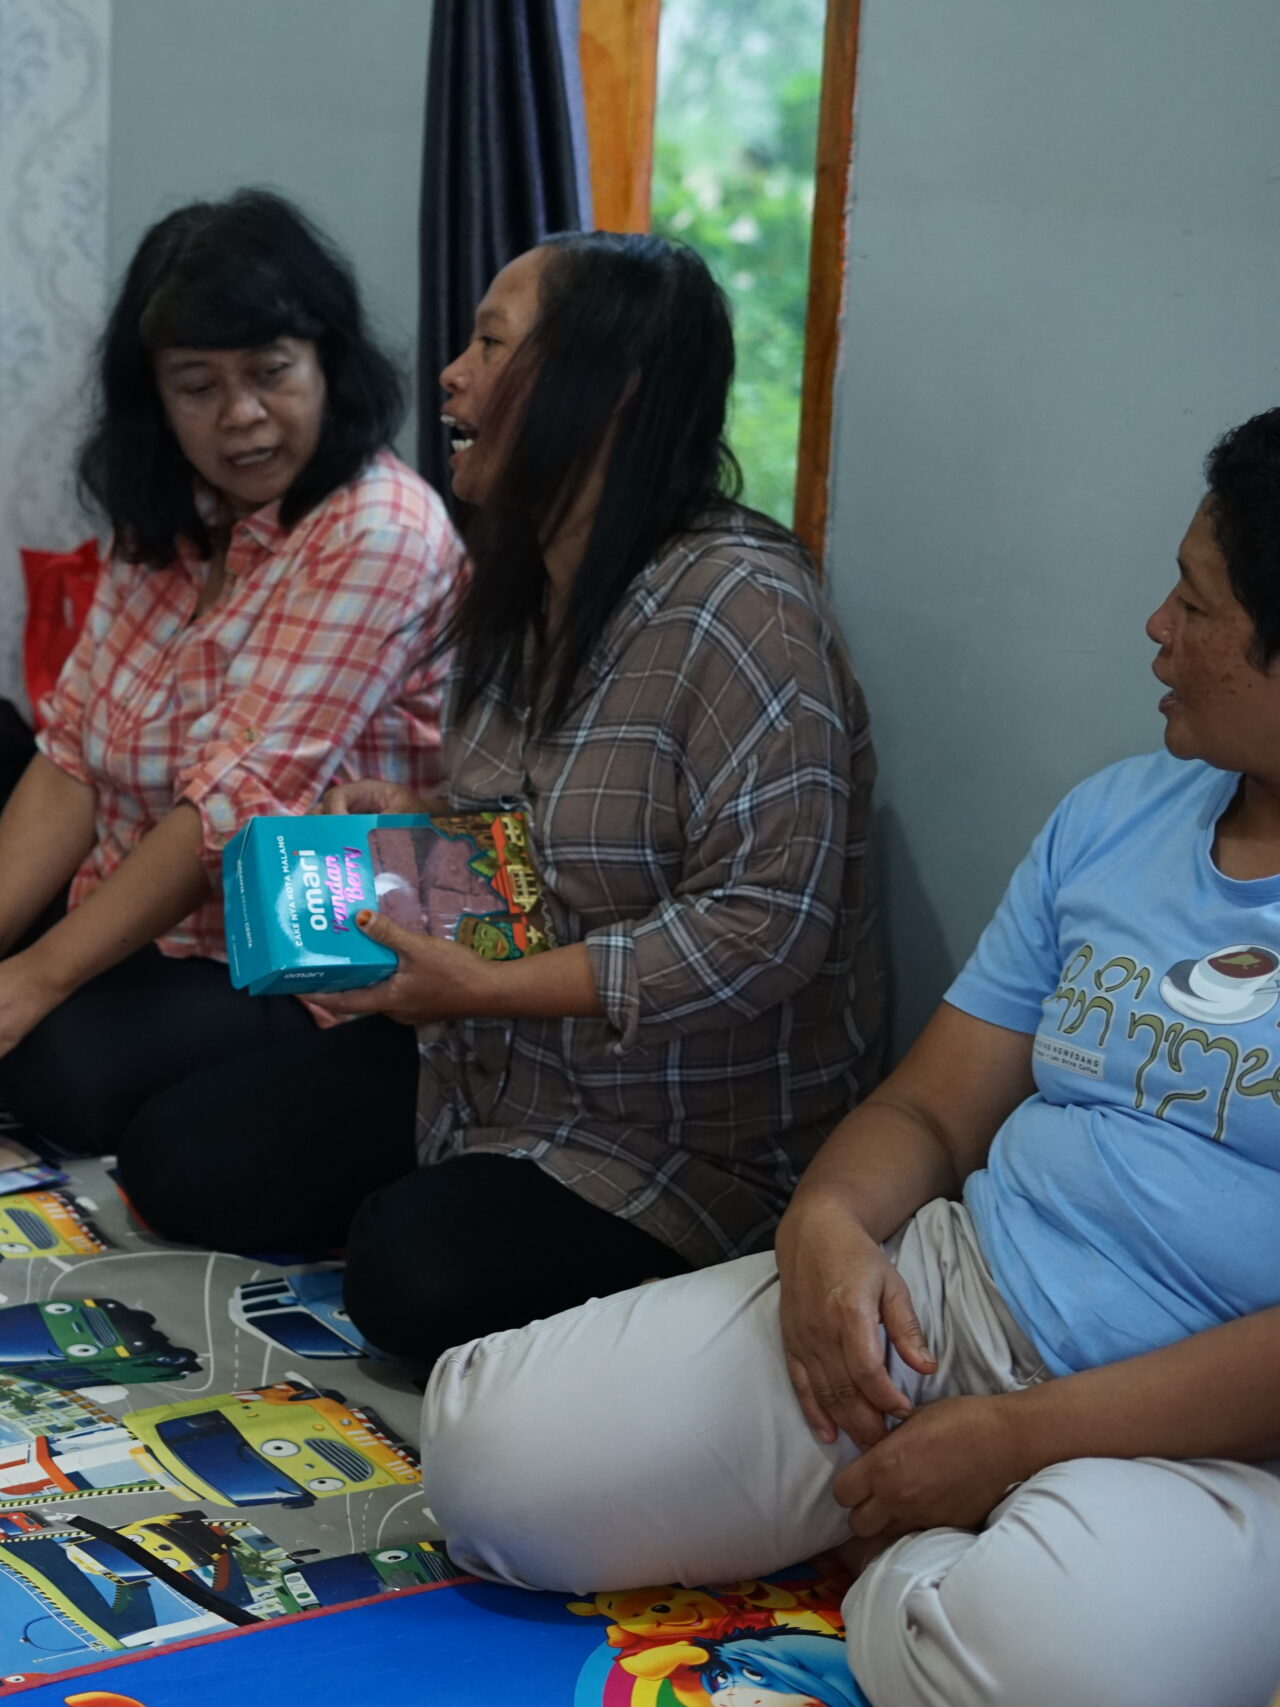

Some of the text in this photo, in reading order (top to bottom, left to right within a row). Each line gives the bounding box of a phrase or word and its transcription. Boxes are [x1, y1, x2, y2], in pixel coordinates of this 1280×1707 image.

[276, 835, 304, 947] CAKE NYA KOTA MALANG
[293, 849, 328, 931] omari
[324, 854, 350, 934] Pandan
[342, 846, 365, 903] Berry
